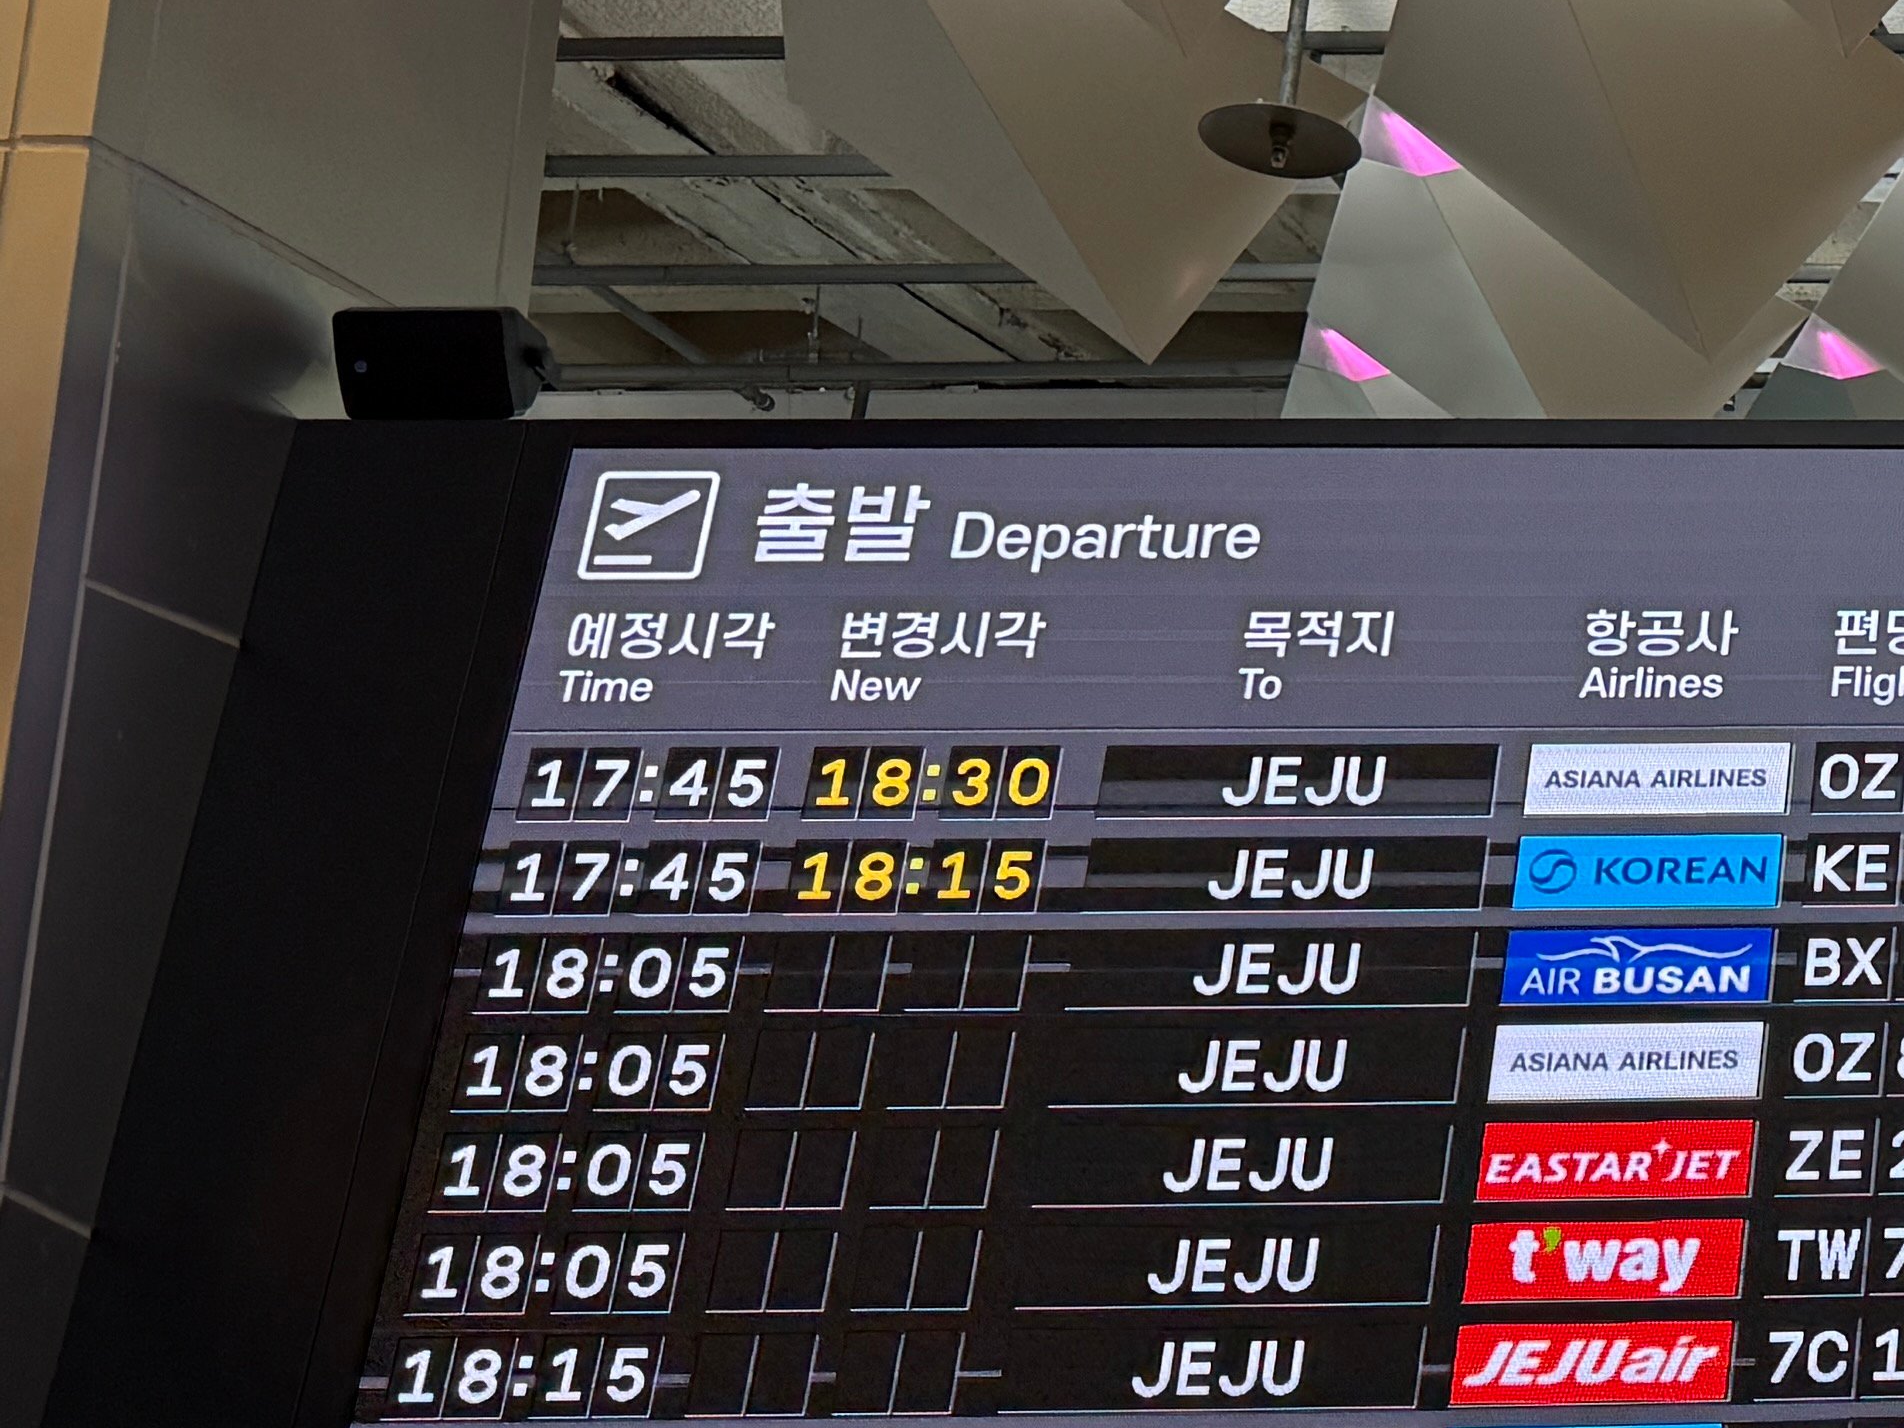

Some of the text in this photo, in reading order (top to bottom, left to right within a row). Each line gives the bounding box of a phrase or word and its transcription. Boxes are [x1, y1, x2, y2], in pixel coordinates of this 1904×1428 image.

[754, 482, 931, 562] 출발
[950, 511, 1261, 573] Departure
[567, 612, 776, 660] 예정시각
[840, 611, 1047, 659] 변경시각
[1243, 610, 1395, 658] 목적지
[1586, 608, 1739, 657] 항공사
[559, 670, 653, 703] Time
[830, 669, 922, 702] New
[1238, 667, 1282, 700] To
[1578, 666, 1723, 699] Airlines
[531, 759, 767, 808] 17:45
[815, 758, 1050, 807] 18:30
[1222, 756, 1387, 807] JEJU
[1543, 768, 1641, 790] ASIANA
[1648, 764, 1769, 789] AIRLINES
[510, 852, 748, 902] 17:45
[797, 851, 1033, 901] 18:15
[1208, 848, 1374, 900] JEJU
[1595, 852, 1770, 886] KOREAN
[488, 947, 730, 999] 18:05
[1193, 942, 1361, 996] JEJU
[1520, 966, 1582, 996] AIR
[1592, 959, 1753, 994] BUSAN
[398, 1347, 649, 1404] 18:15
[1131, 1340, 1305, 1398] JEJU
[1462, 1337, 1721, 1390] JEJUair
